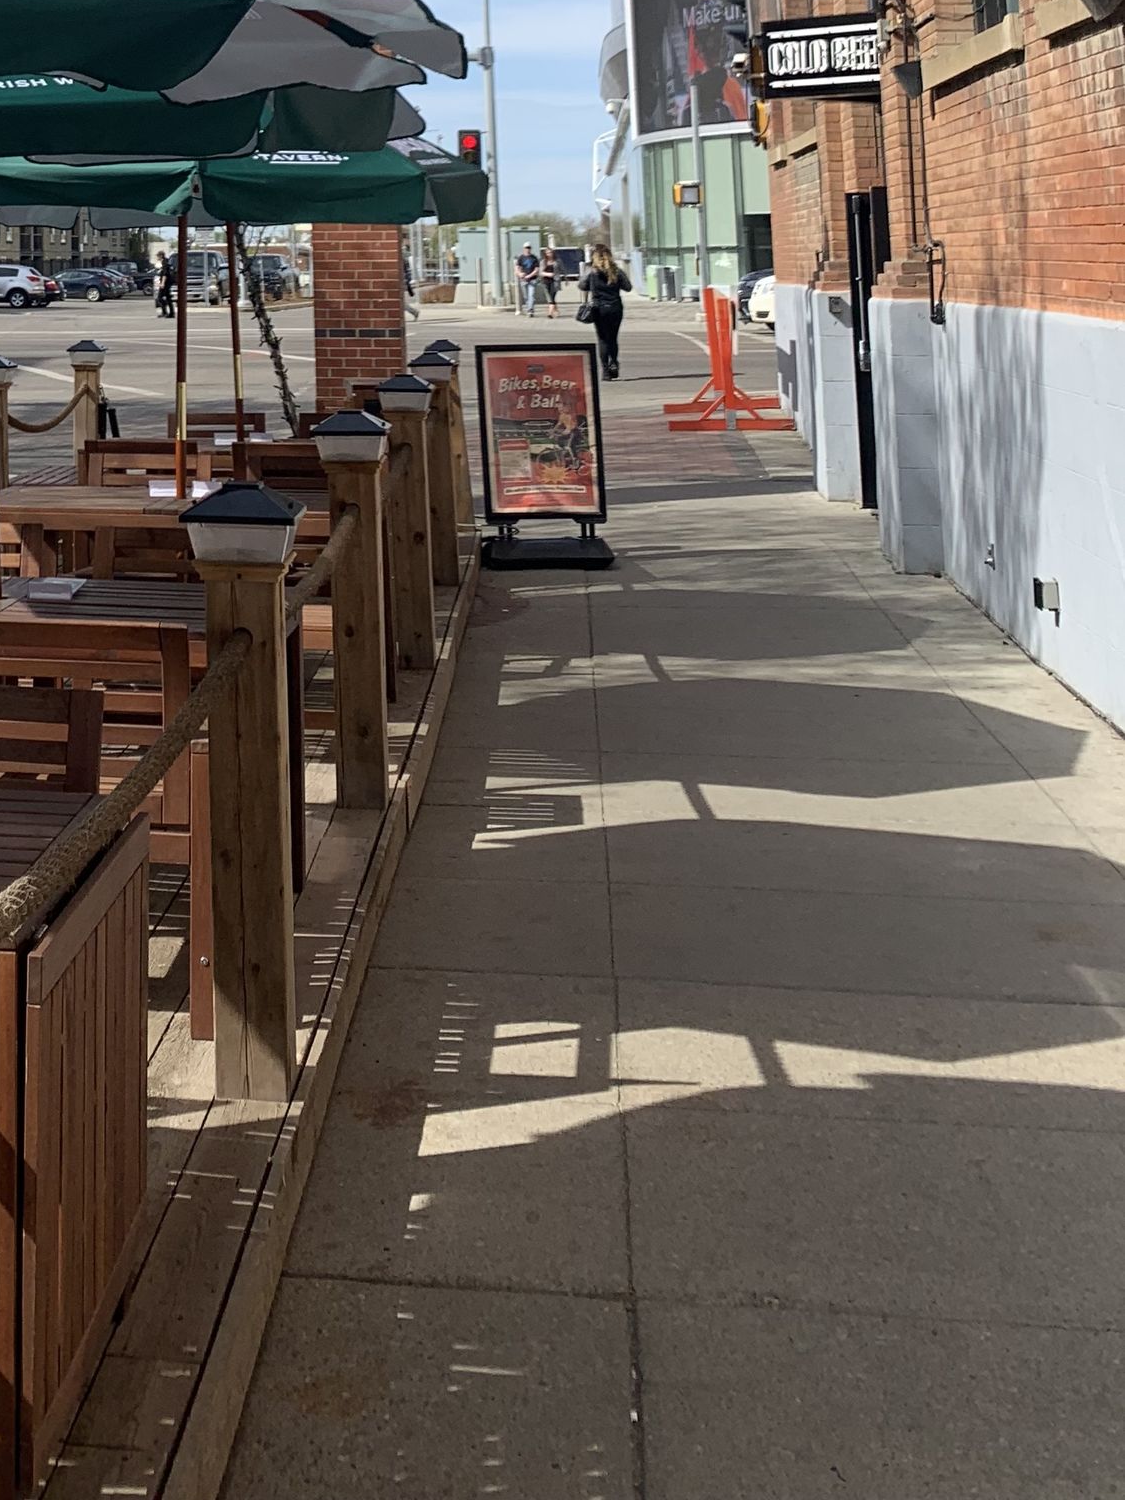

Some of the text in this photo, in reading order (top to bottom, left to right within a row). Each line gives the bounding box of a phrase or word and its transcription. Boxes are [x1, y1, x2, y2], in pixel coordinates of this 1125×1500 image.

[682, 3, 721, 29] Make
[767, 38, 828, 76] COLD
[541, 374, 577, 390] Beer
[516, 395, 525, 410] &
